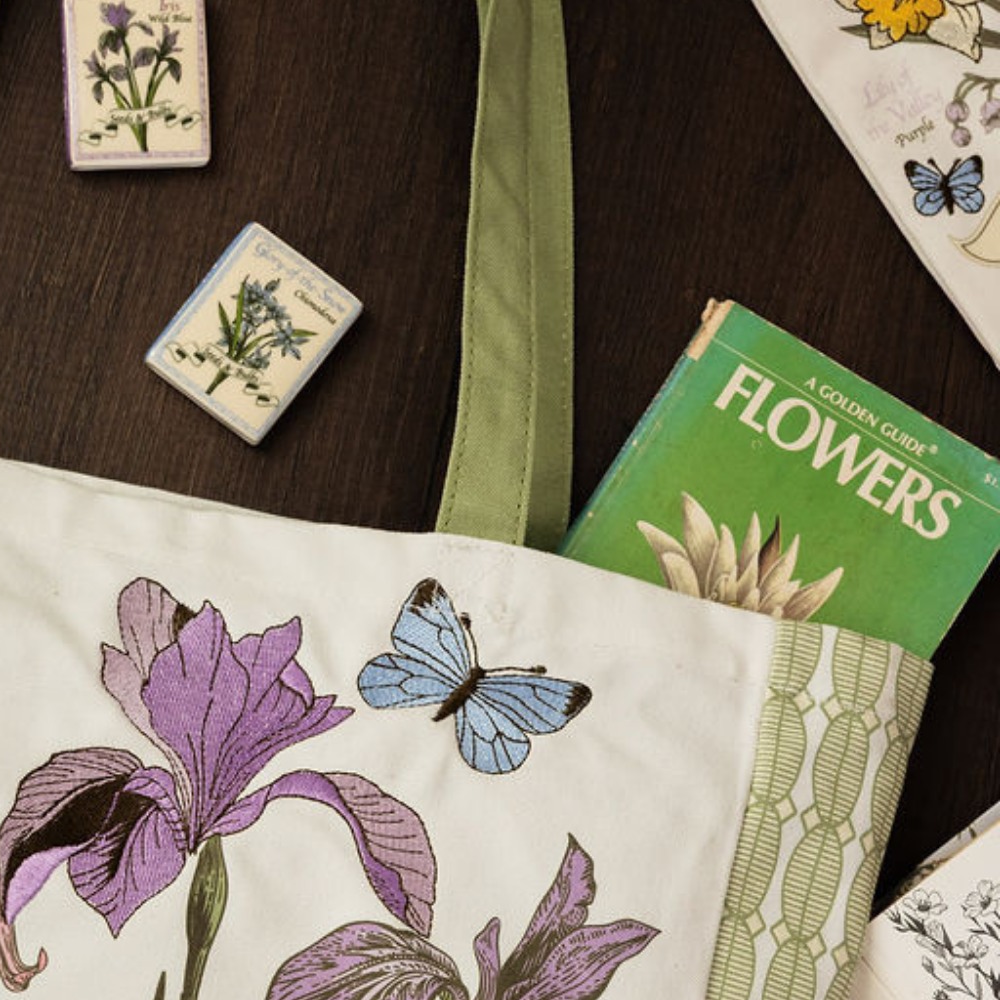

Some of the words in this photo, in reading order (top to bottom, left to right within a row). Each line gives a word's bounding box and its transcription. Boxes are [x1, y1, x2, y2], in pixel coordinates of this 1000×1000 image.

[894, 115, 935, 148] Purple
[803, 376, 816, 390] A
[819, 383, 880, 428] GOLDEN
[714, 363, 962, 539] FLOWERS
